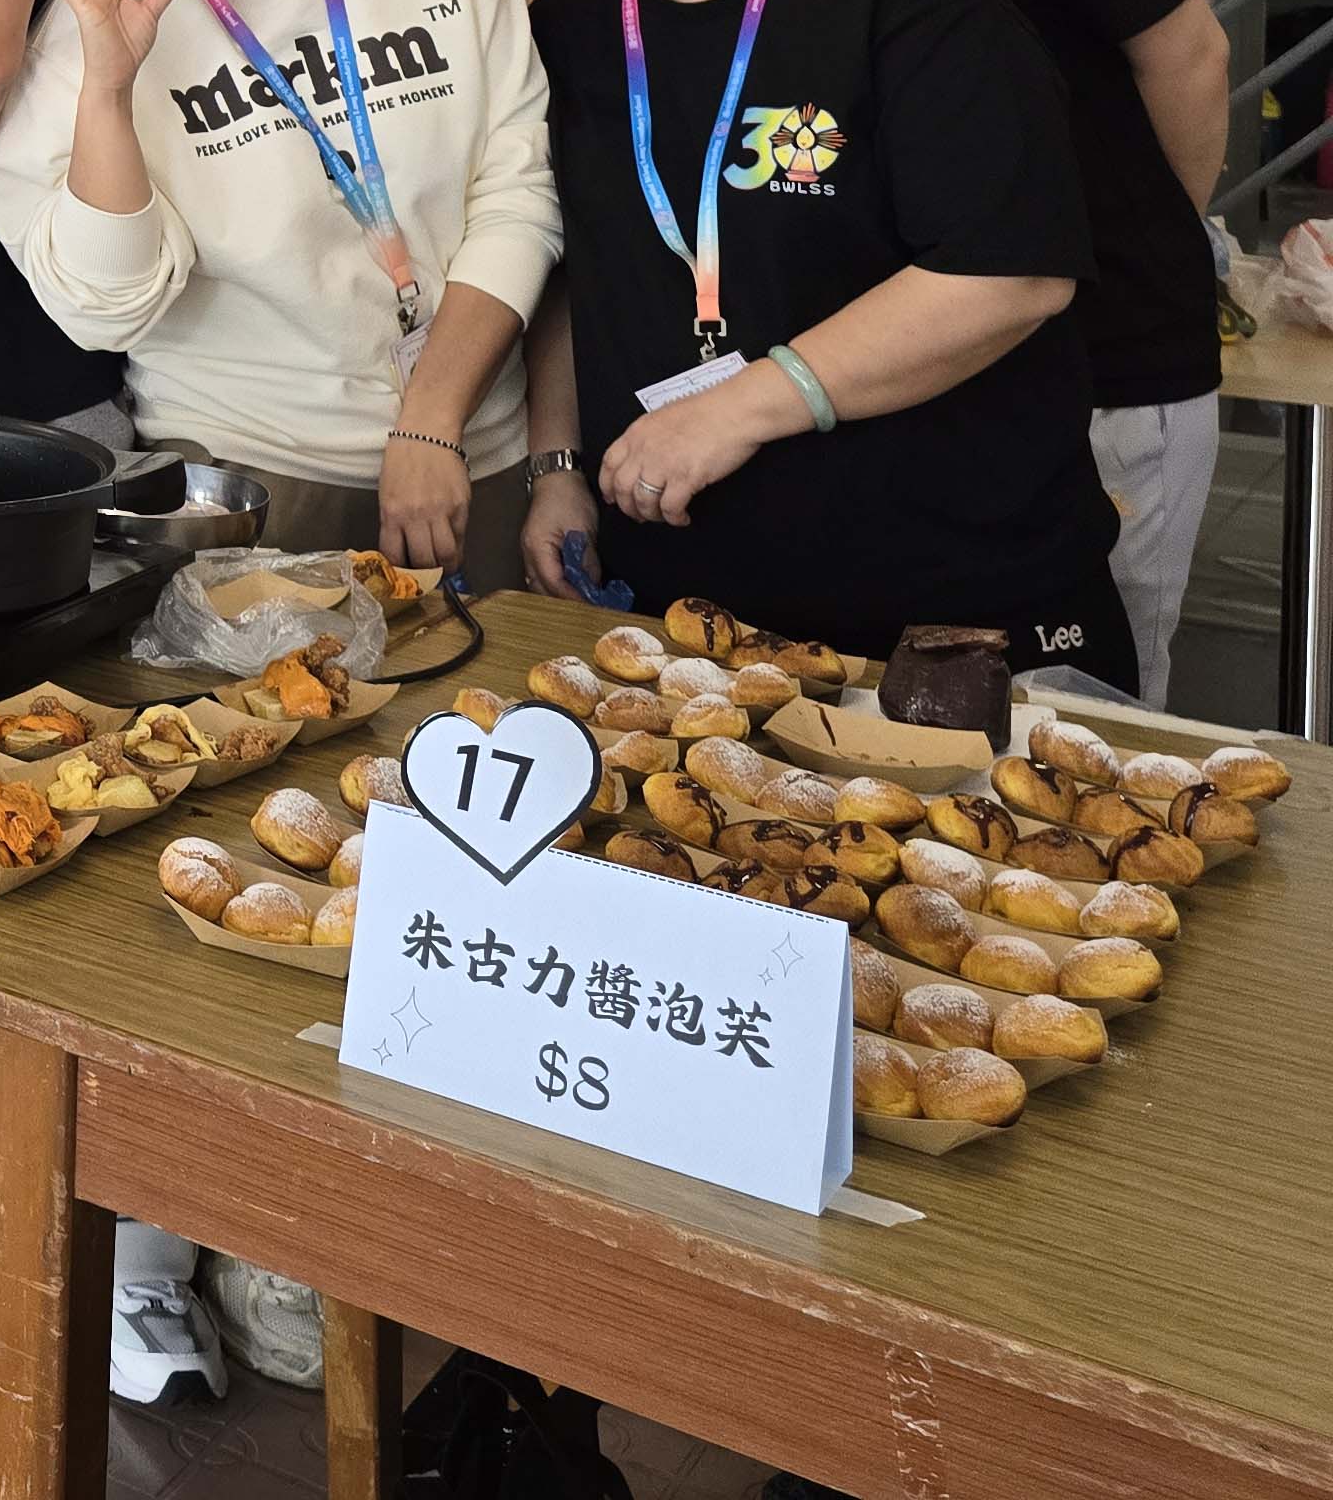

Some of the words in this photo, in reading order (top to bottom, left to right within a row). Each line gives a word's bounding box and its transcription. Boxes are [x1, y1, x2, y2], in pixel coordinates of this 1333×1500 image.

[195, 139, 233, 158] PEACE
[235, 123, 271, 147] LOVE
[367, 97, 395, 114] THE
[399, 83, 456, 107] MOMENT
[769, 179, 836, 196] BWLSS
[1035, 622, 1085, 653] Lee
[455, 744, 535, 823] 17
[401, 909, 775, 1069] 朱古力醬泡芙
[534, 1041, 611, 1113] $8
